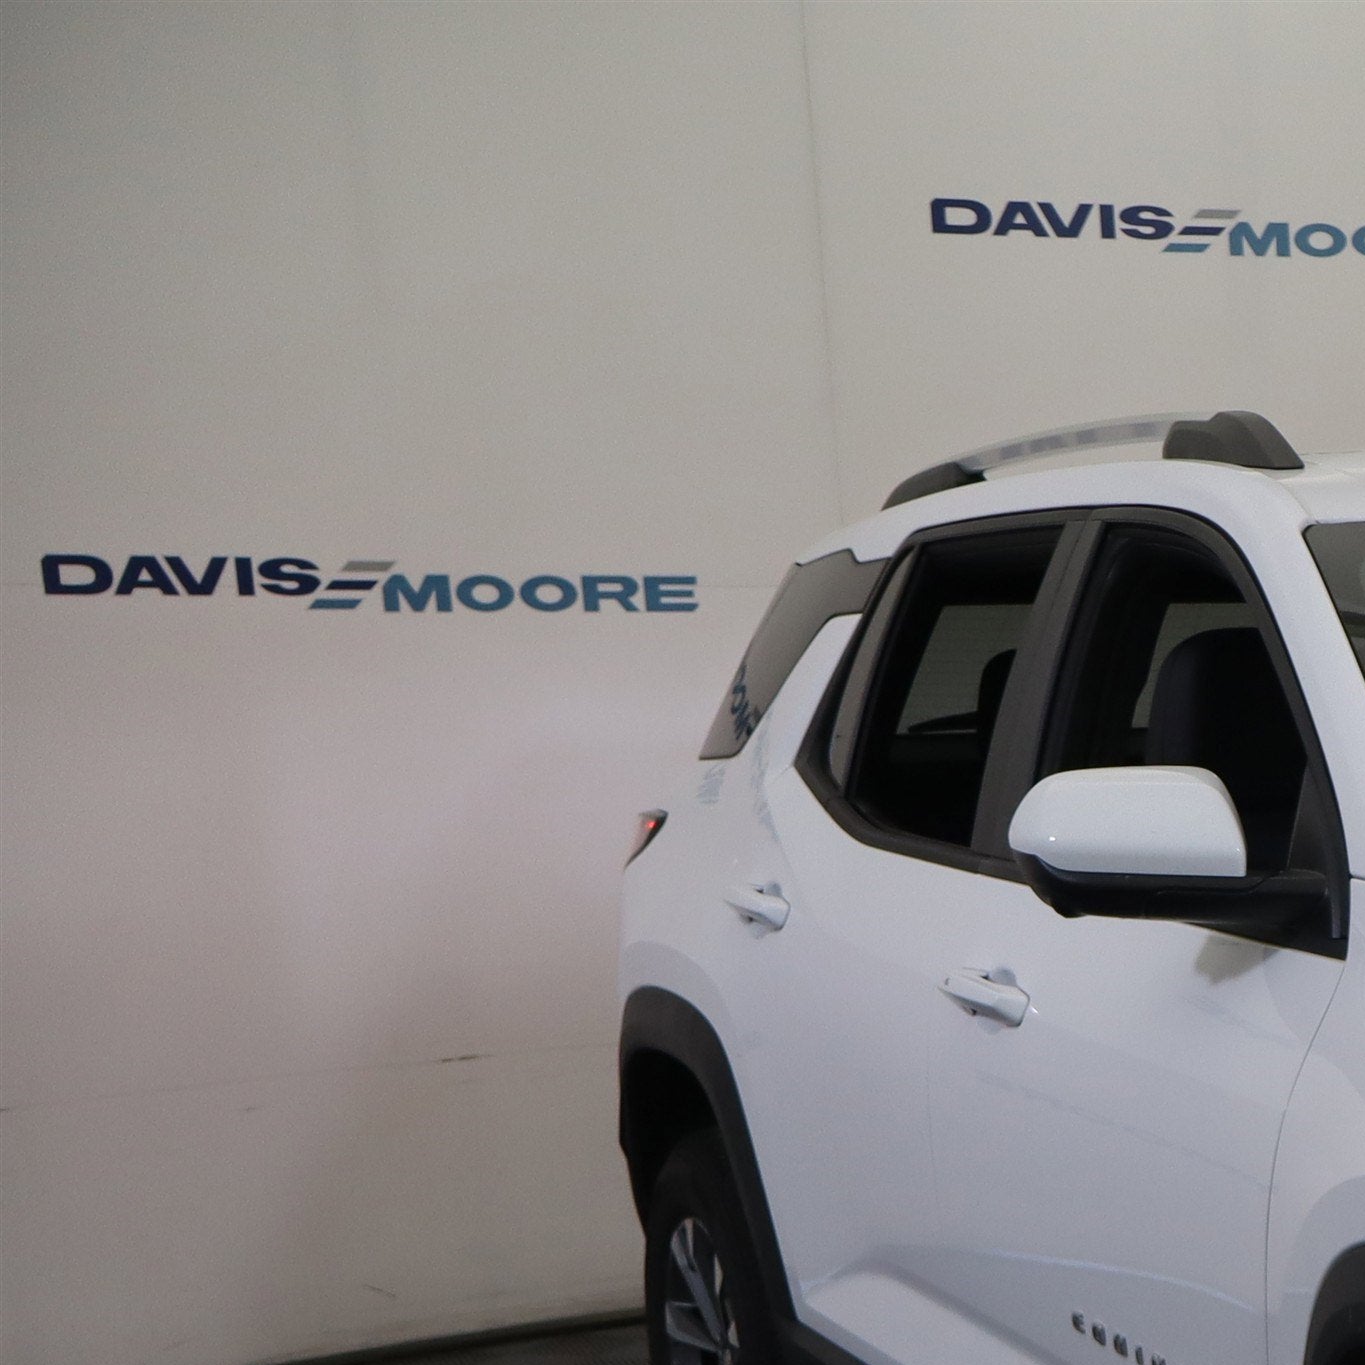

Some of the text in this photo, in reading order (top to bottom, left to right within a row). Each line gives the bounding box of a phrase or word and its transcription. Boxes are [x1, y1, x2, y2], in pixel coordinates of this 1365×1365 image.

[930, 198, 1176, 241] DAVIS
[40, 554, 700, 613] DAVIS MOORE
